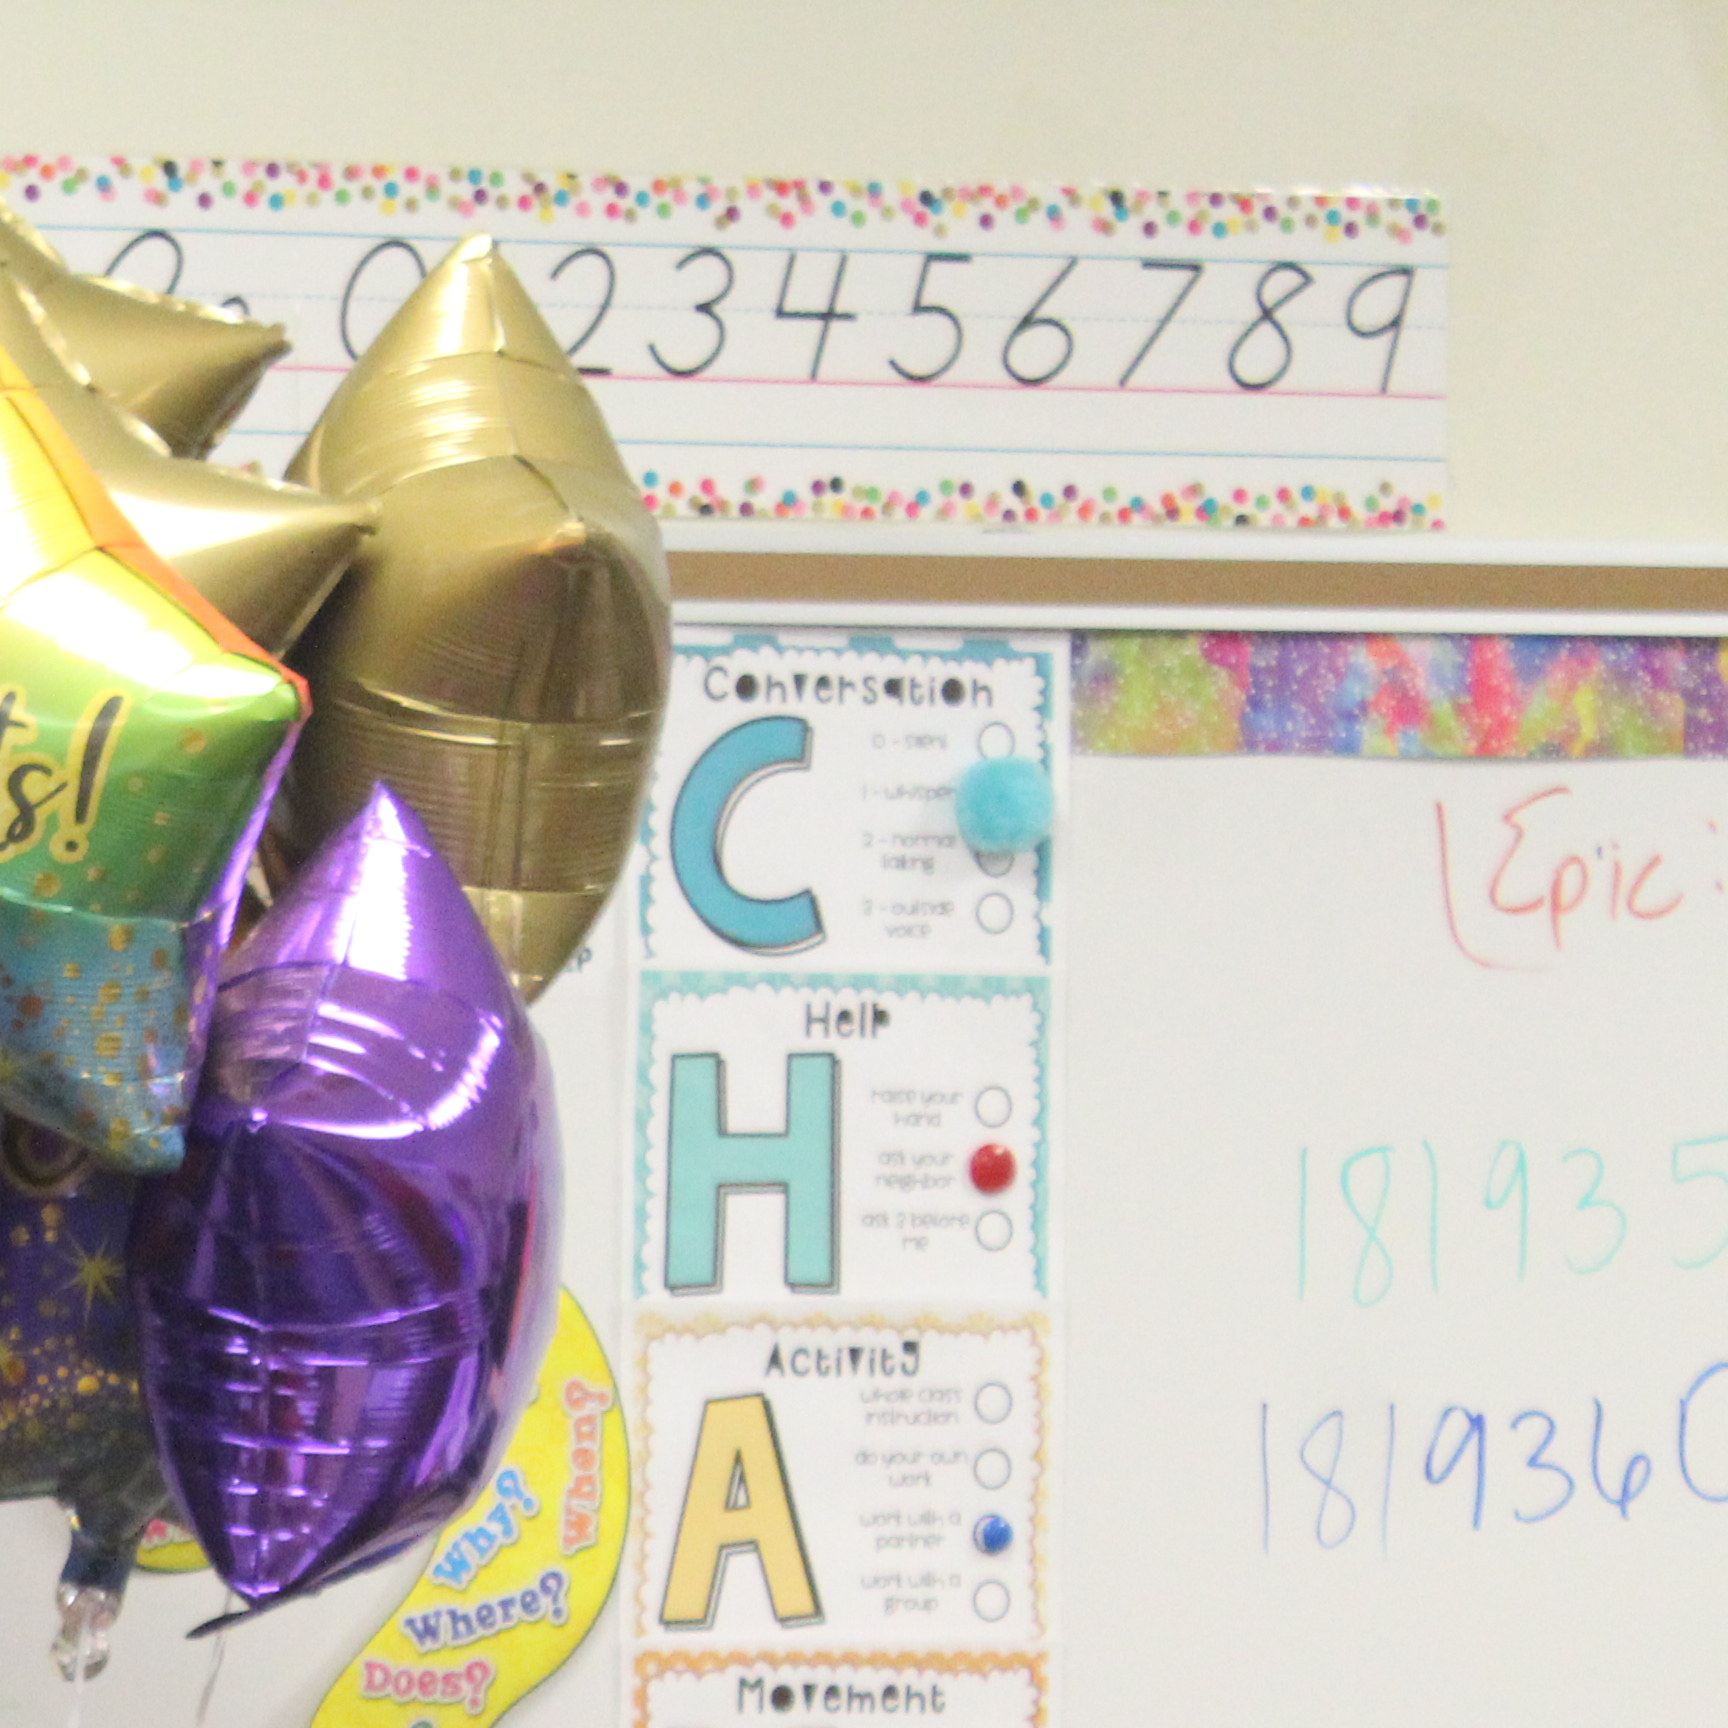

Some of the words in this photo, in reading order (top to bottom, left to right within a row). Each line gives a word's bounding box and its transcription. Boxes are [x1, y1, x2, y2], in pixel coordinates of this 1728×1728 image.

[702, 664, 995, 710] Conversation
[670, 714, 827, 957] C
[805, 1000, 892, 1041] Help
[664, 1051, 842, 1298] H
[764, 1340, 921, 1378] Activity
[562, 1380, 610, 1552] When?
[432, 1468, 538, 1588] Why?
[659, 1393, 825, 1630] A
[404, 1570, 565, 1648] Where?
[363, 1660, 491, 1713] Does?
[737, 1676, 947, 1716] Movement
